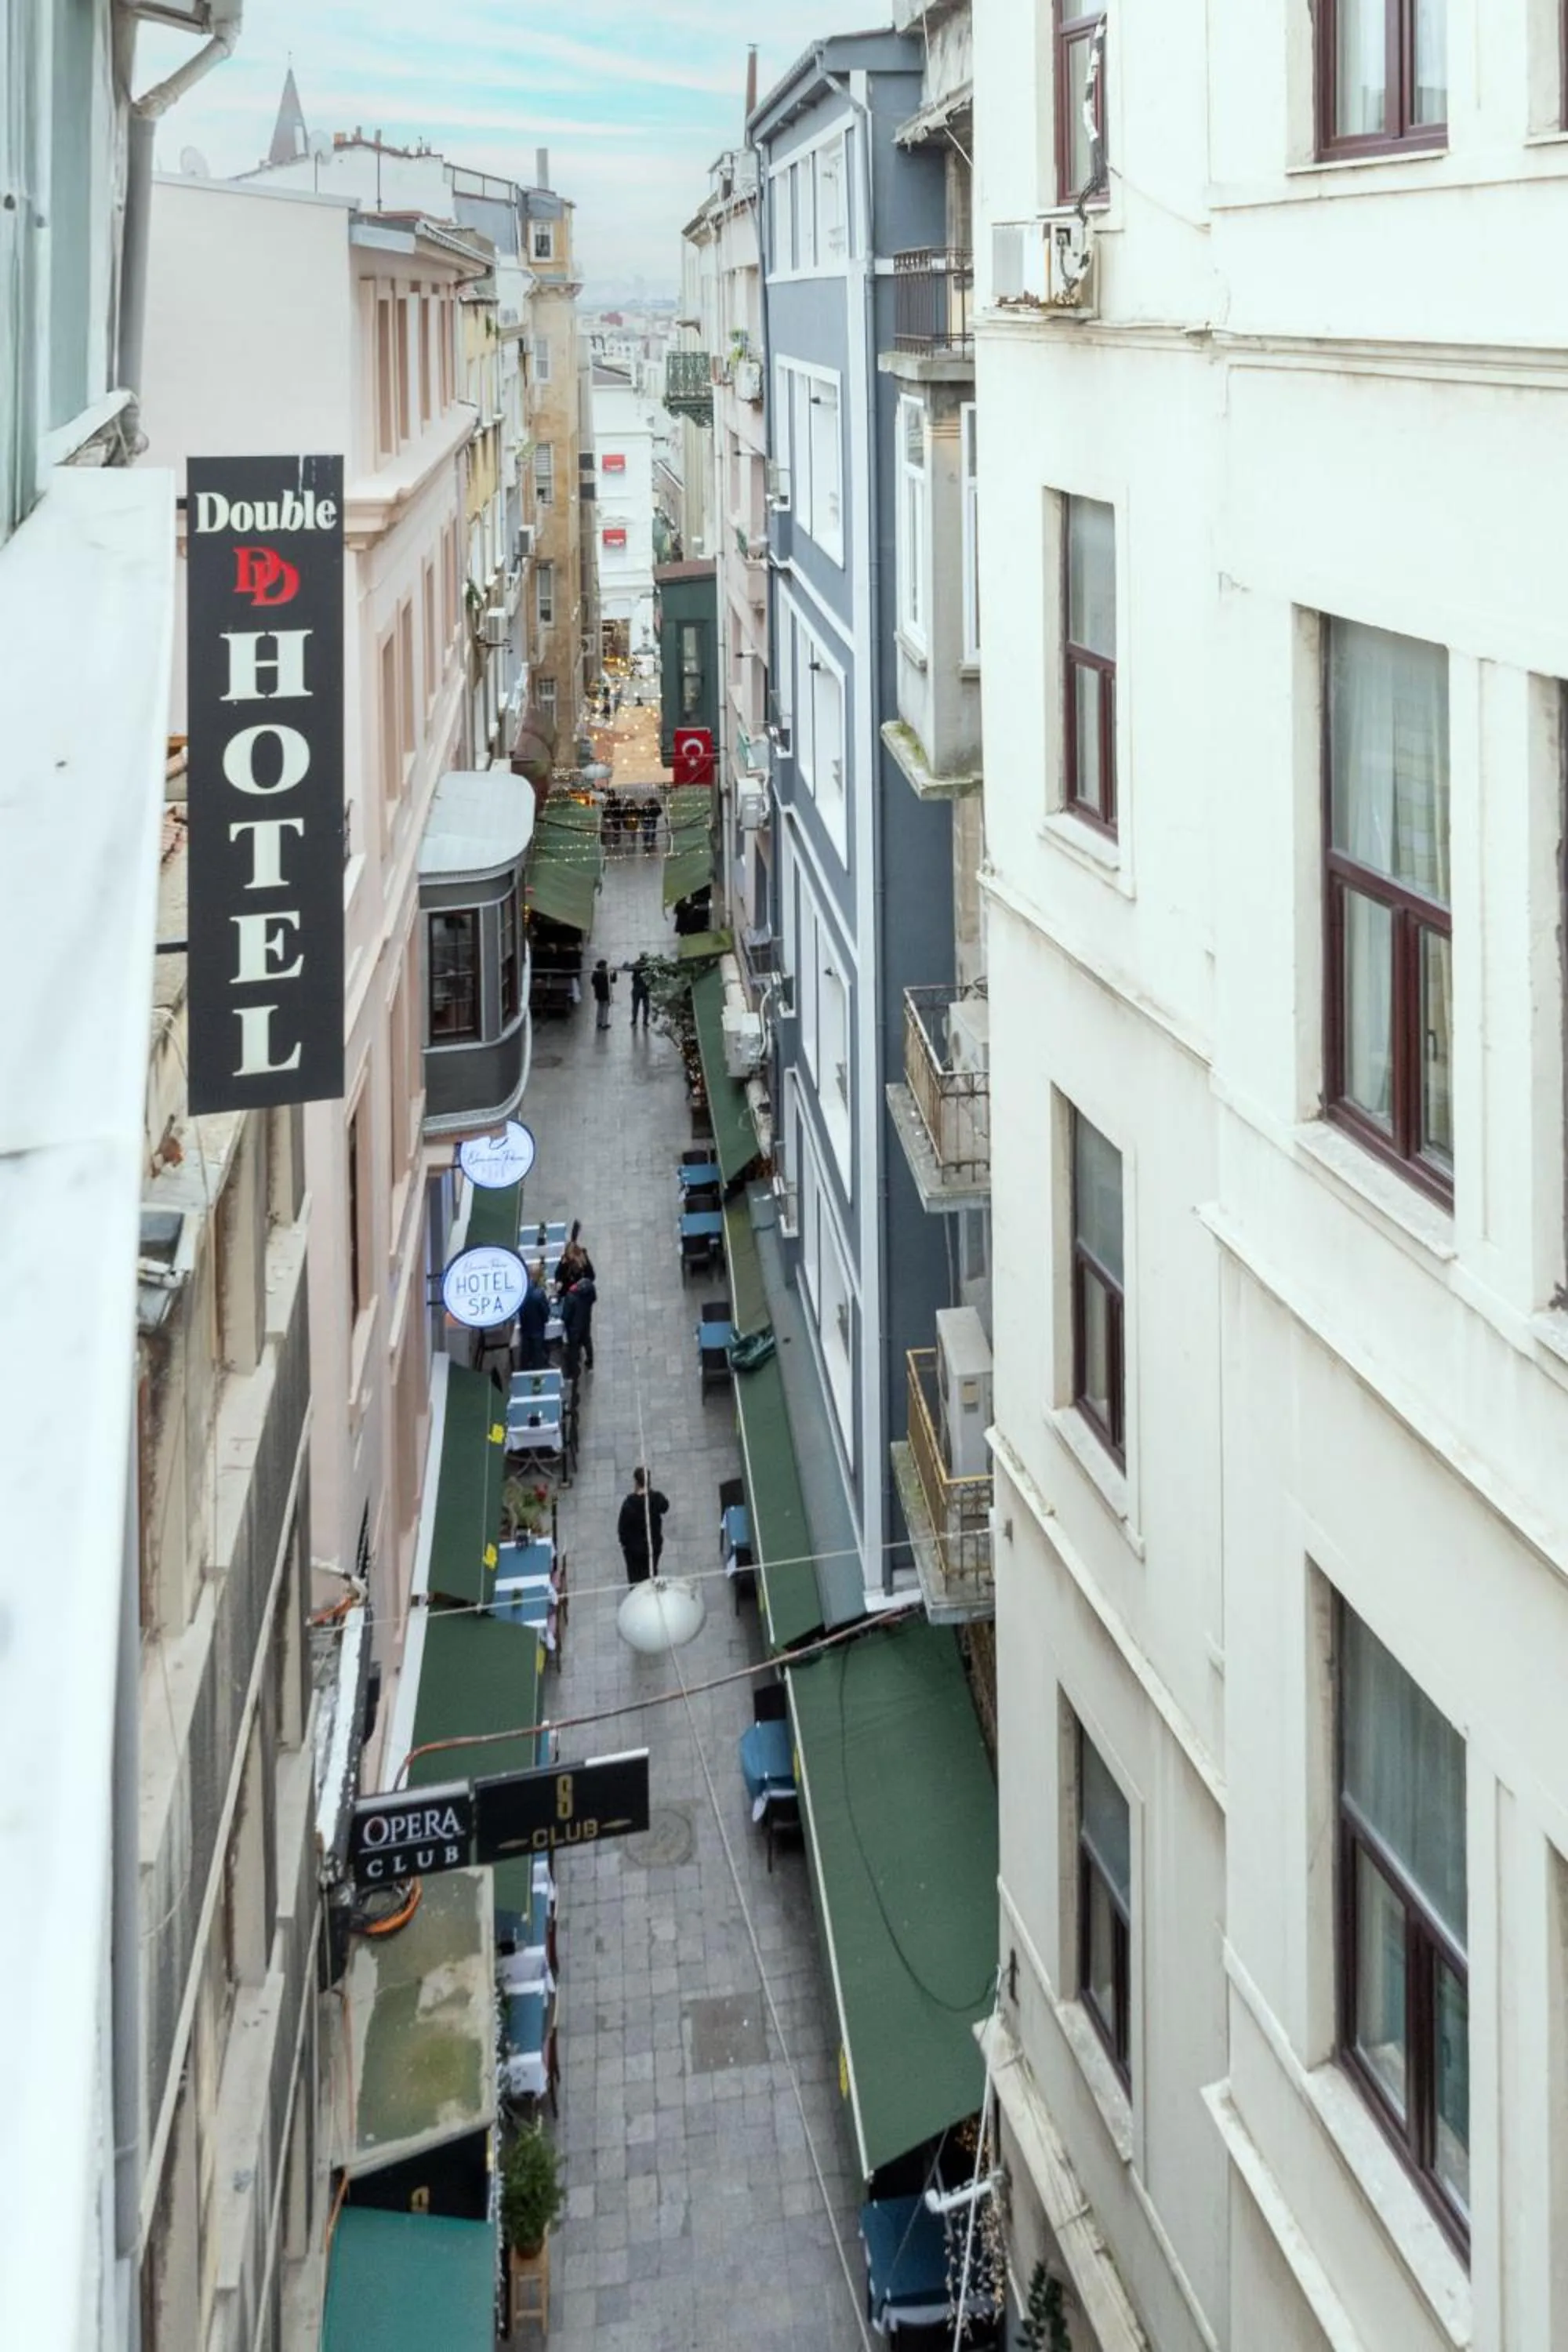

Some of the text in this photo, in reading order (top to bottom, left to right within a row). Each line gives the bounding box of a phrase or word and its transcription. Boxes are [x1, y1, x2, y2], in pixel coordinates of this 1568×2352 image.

[194, 489, 337, 534] Double
[219, 629, 314, 1077] HOTEL
[456, 1271, 515, 1294] HOTEL
[468, 1295, 504, 1316] SPA
[362, 1806, 462, 1846] OPERA
[532, 1818, 599, 1849] CLUB
[366, 1845, 459, 1878] CLUB
